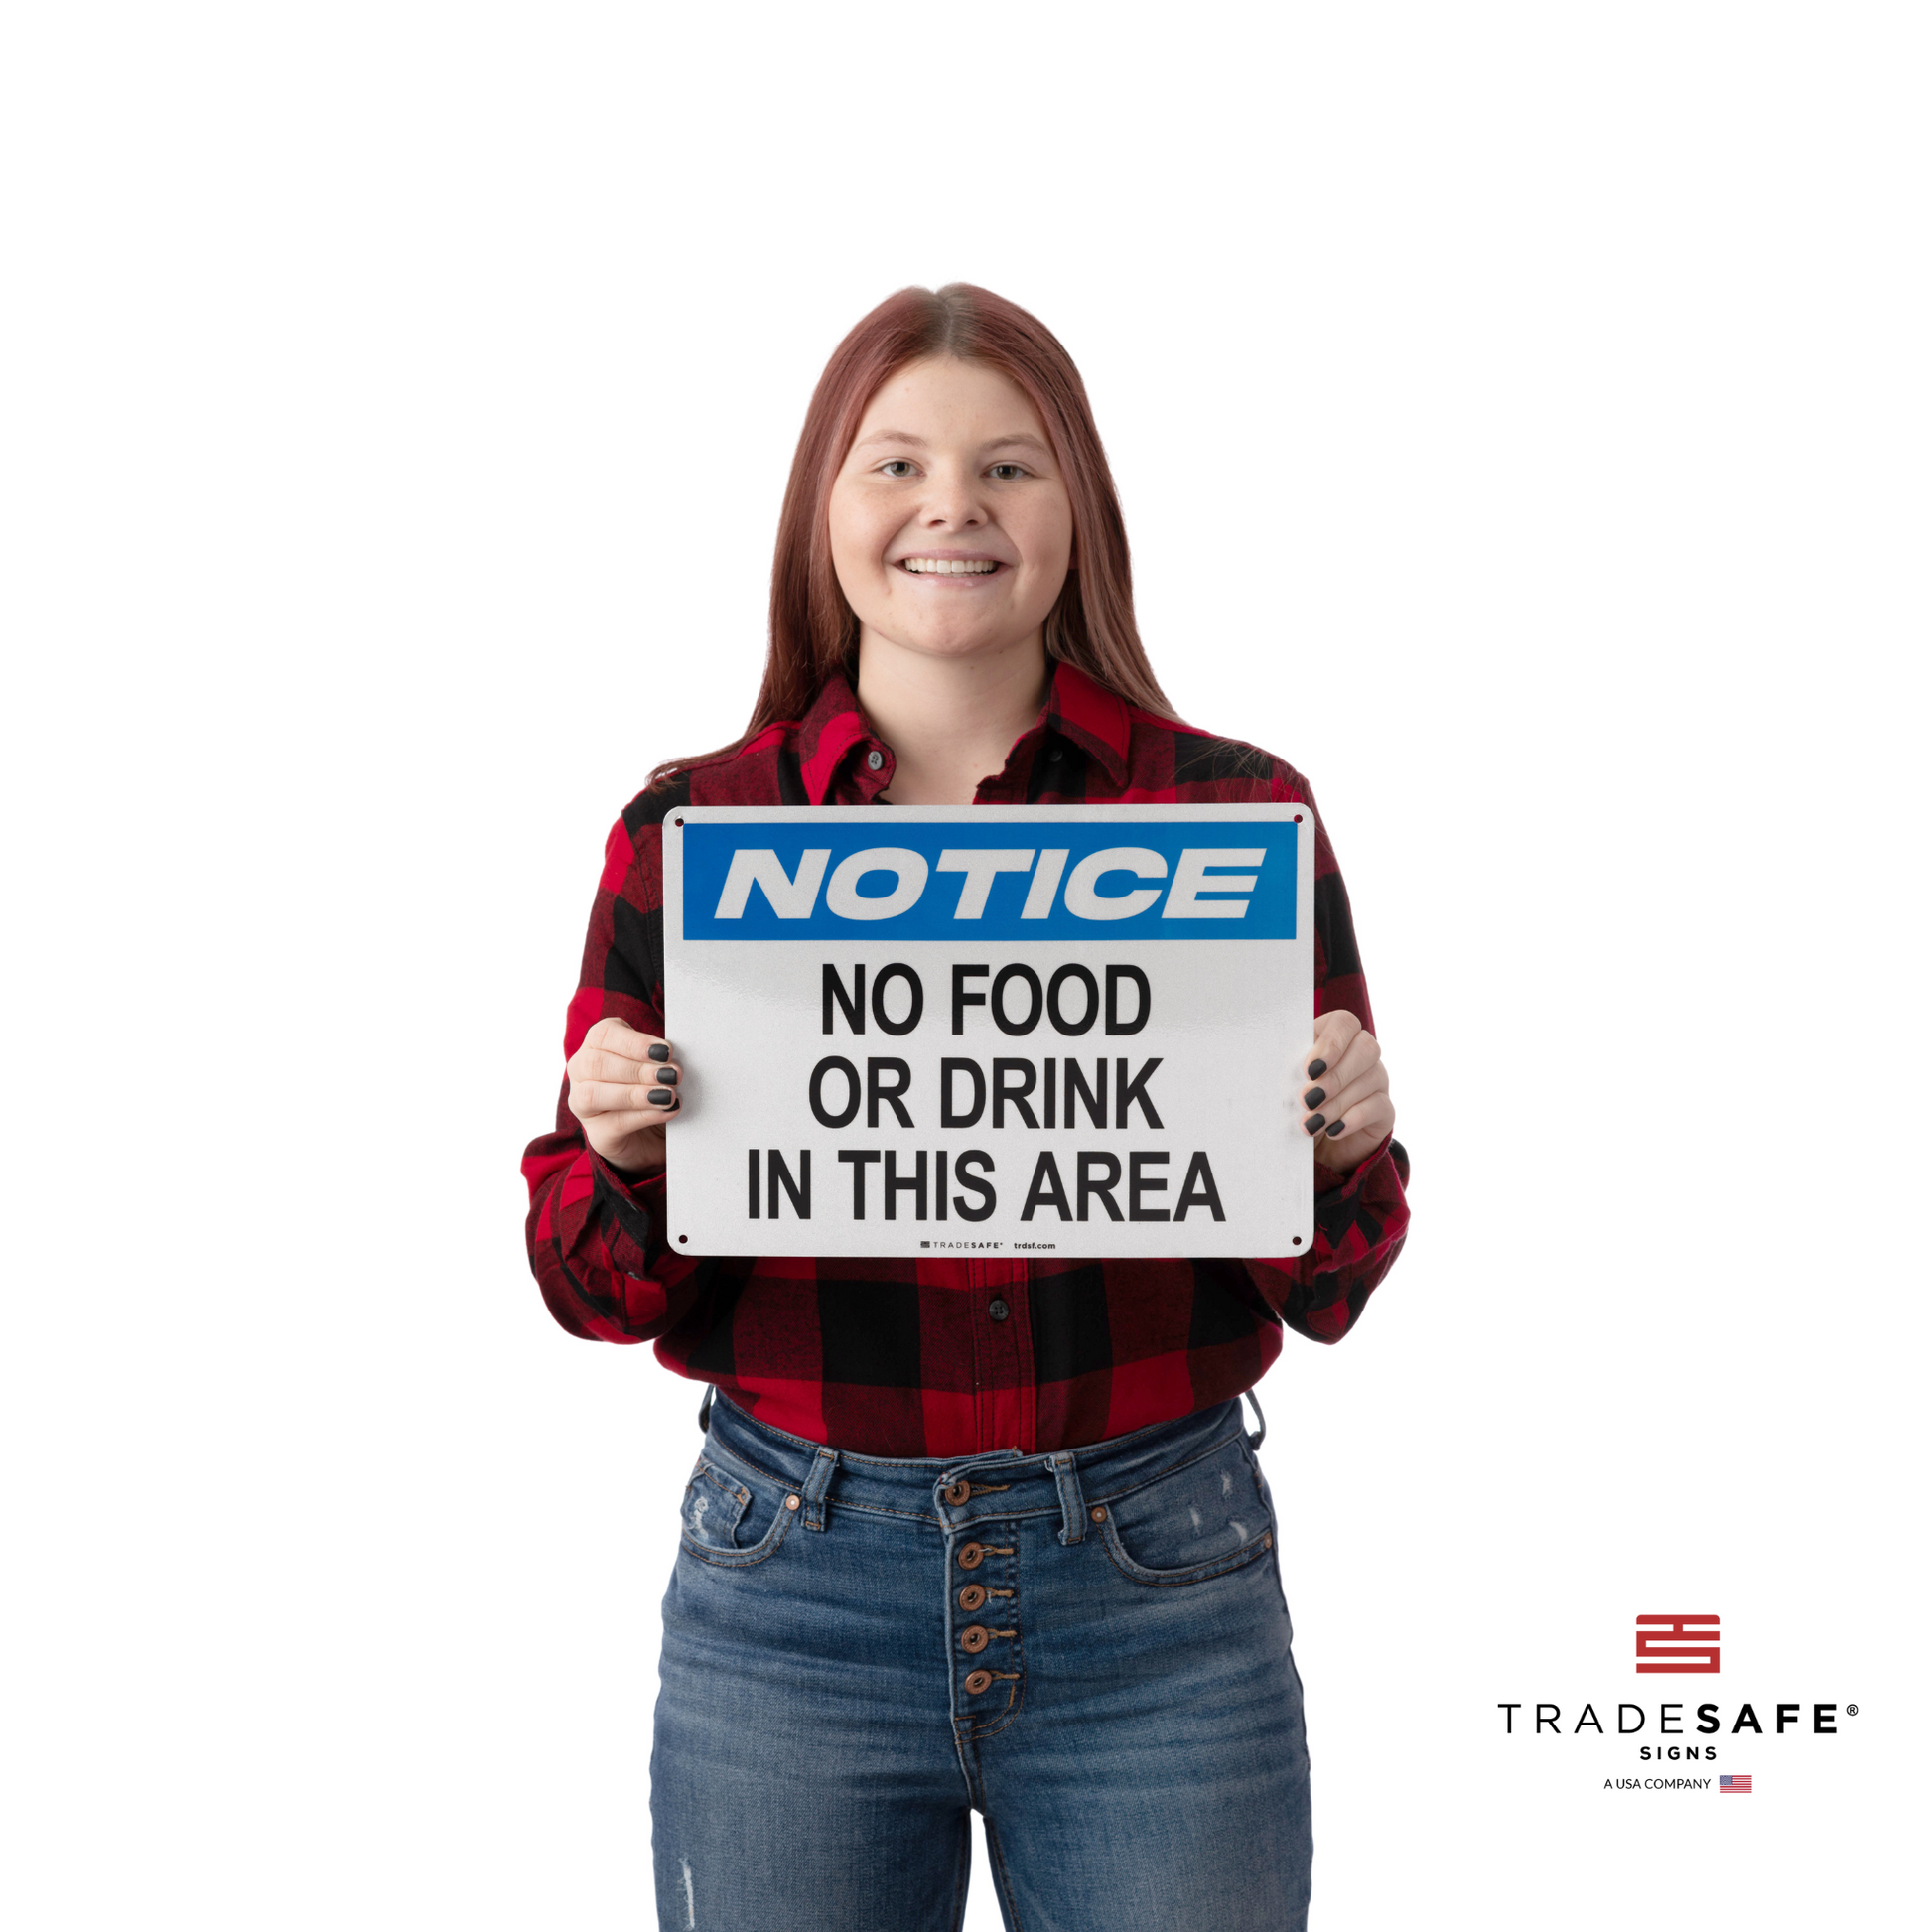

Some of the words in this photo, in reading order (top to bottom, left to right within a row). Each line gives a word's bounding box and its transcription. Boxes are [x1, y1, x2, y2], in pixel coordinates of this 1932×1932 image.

[714, 846, 1267, 921] NOTICE
[823, 963, 923, 1036] NO
[952, 963, 1152, 1037] FOOD
[809, 1056, 914, 1129] OR
[941, 1057, 1164, 1130] DRINK
[749, 1150, 811, 1220] IN
[838, 1150, 997, 1223] THIS
[1021, 1151, 1227, 1222] AREA
